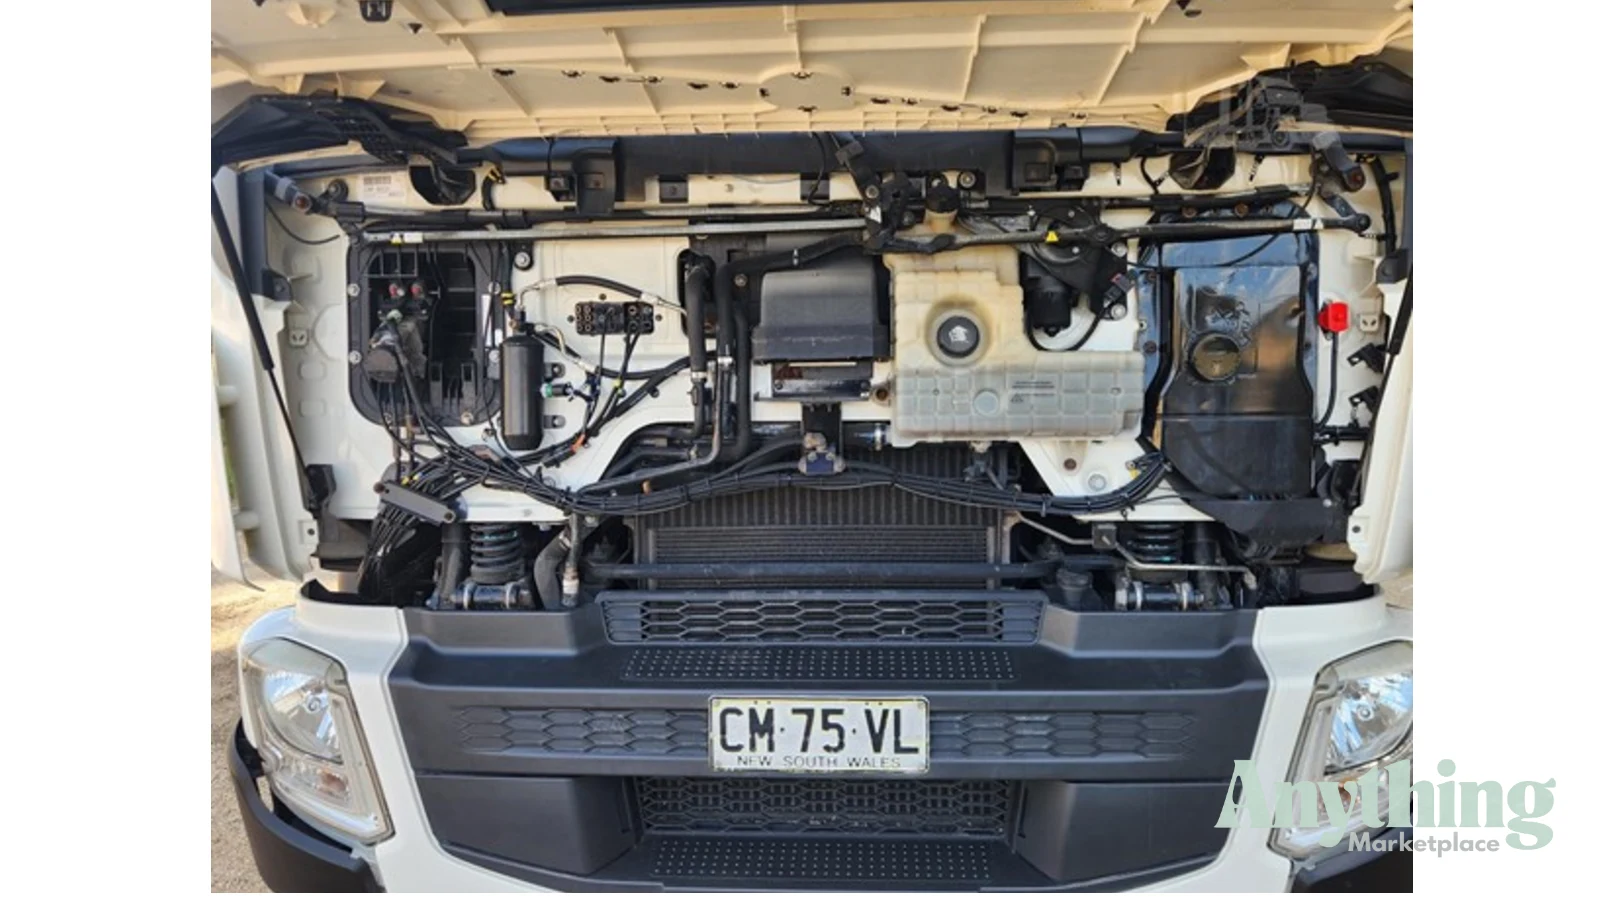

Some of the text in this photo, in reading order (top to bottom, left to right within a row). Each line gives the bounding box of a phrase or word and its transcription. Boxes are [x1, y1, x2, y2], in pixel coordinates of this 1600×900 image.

[737, 756, 901, 768] NEW SOUTH WALES
